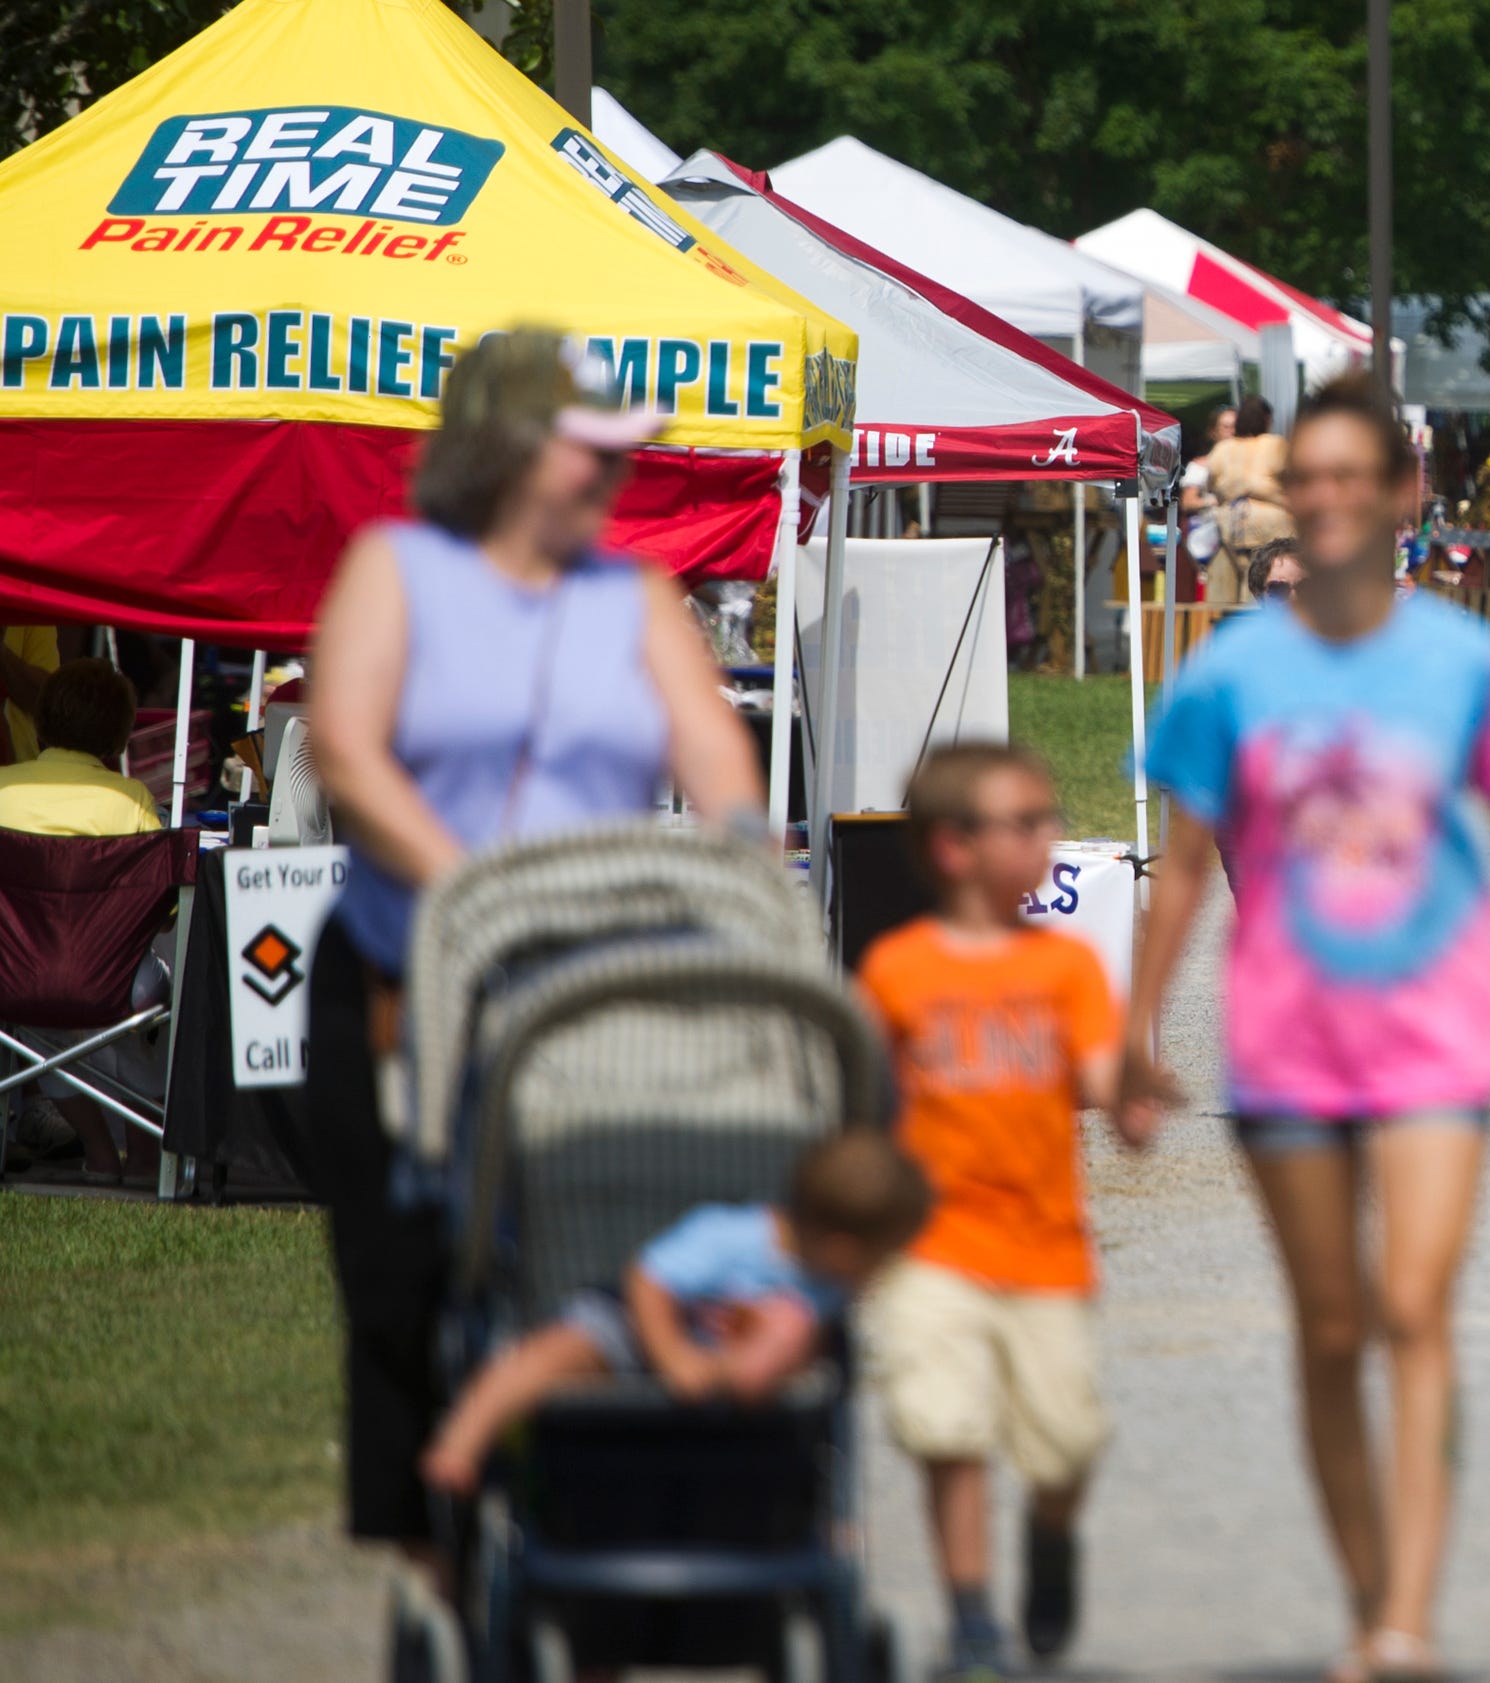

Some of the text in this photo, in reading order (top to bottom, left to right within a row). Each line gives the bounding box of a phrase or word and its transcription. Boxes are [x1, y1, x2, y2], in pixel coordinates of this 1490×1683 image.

[164, 111, 463, 178] REAL
[153, 161, 461, 221] TIME
[78, 218, 244, 253] Pain
[1, 312, 187, 391] PAIN
[208, 309, 458, 400] RELIEF
[238, 866, 272, 890] Get
[277, 863, 324, 888] Your
[246, 1037, 291, 1071] Call
